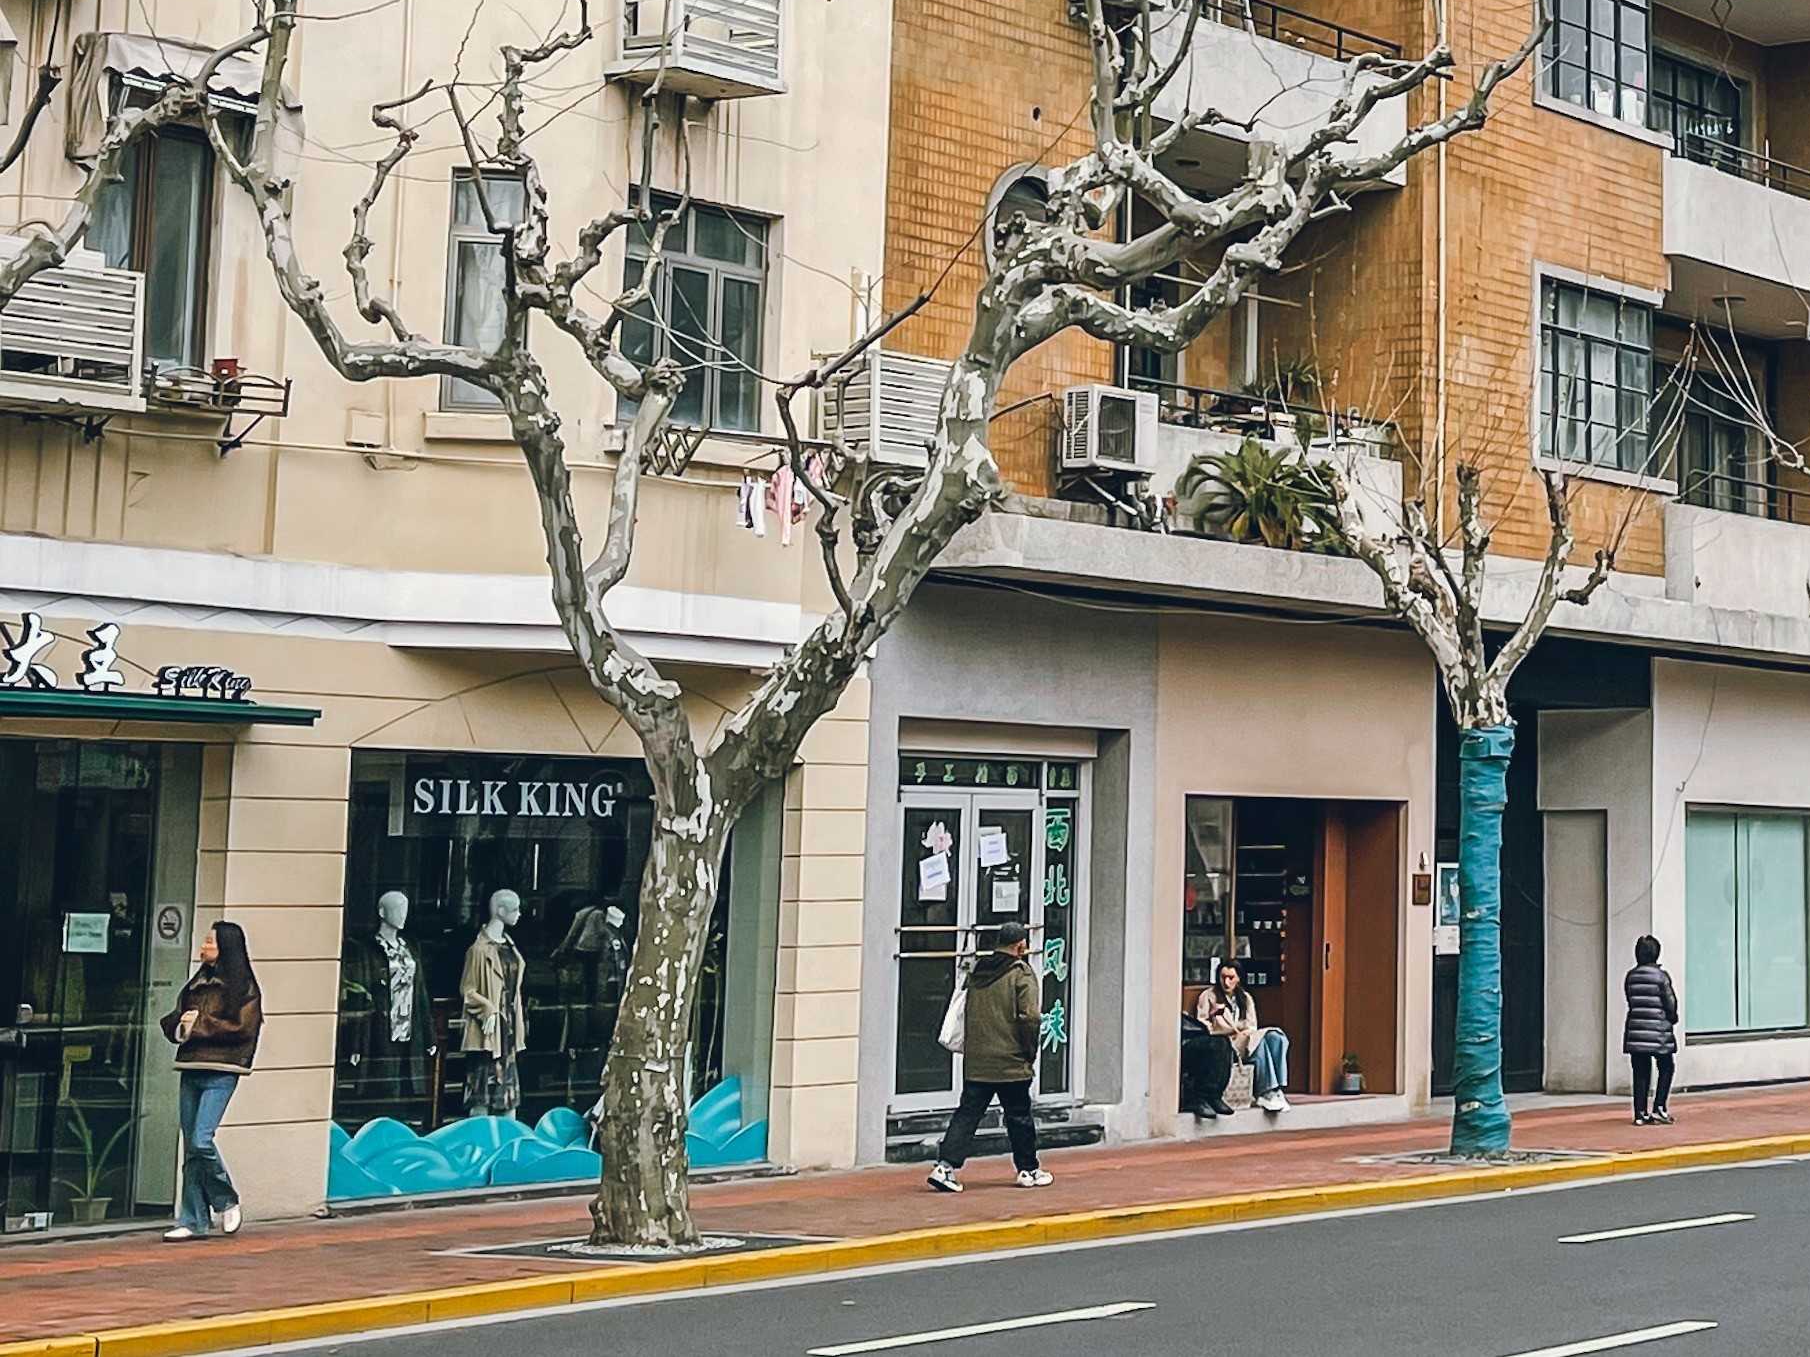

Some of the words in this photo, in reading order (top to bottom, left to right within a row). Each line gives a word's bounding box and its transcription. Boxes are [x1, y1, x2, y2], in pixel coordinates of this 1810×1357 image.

[2, 611, 126, 689] 大王
[413, 777, 508, 815] SILK
[516, 780, 617, 817] KING
[1040, 807, 1071, 1054] 西北风味
